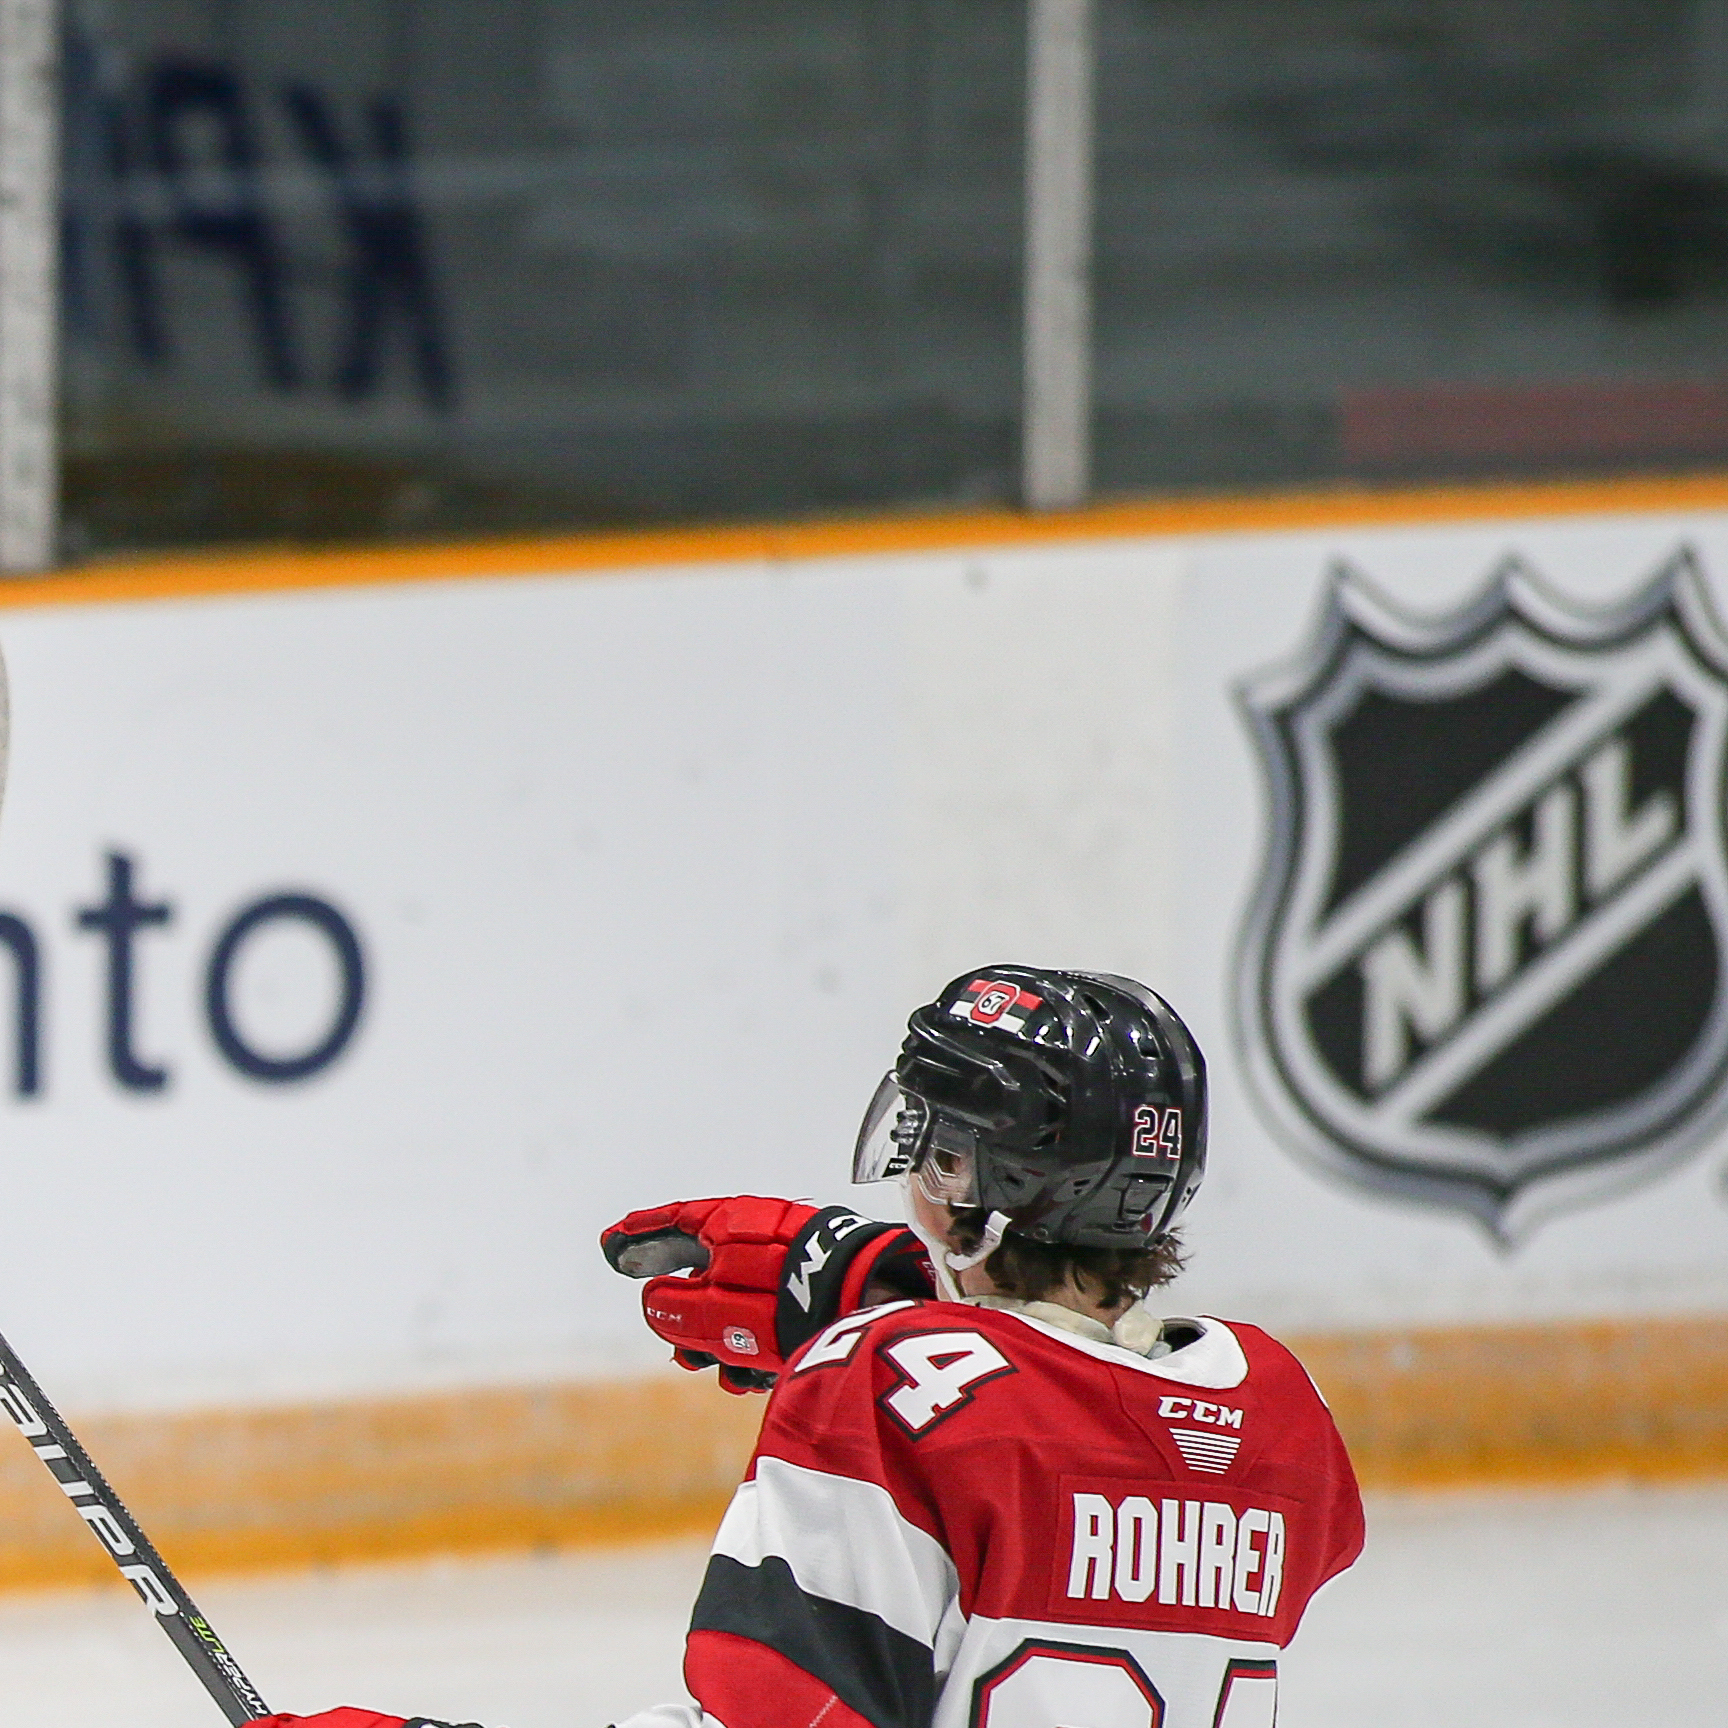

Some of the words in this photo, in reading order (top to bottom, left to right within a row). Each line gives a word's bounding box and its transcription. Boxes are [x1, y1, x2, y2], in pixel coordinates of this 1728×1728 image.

[1359, 735, 1681, 1092] NHL
[1132, 1103, 1183, 1159] 24
[792, 1300, 1018, 1441] 24
[1158, 1396, 1244, 1430] CCM
[1066, 1491, 1286, 1619] ROHRER
